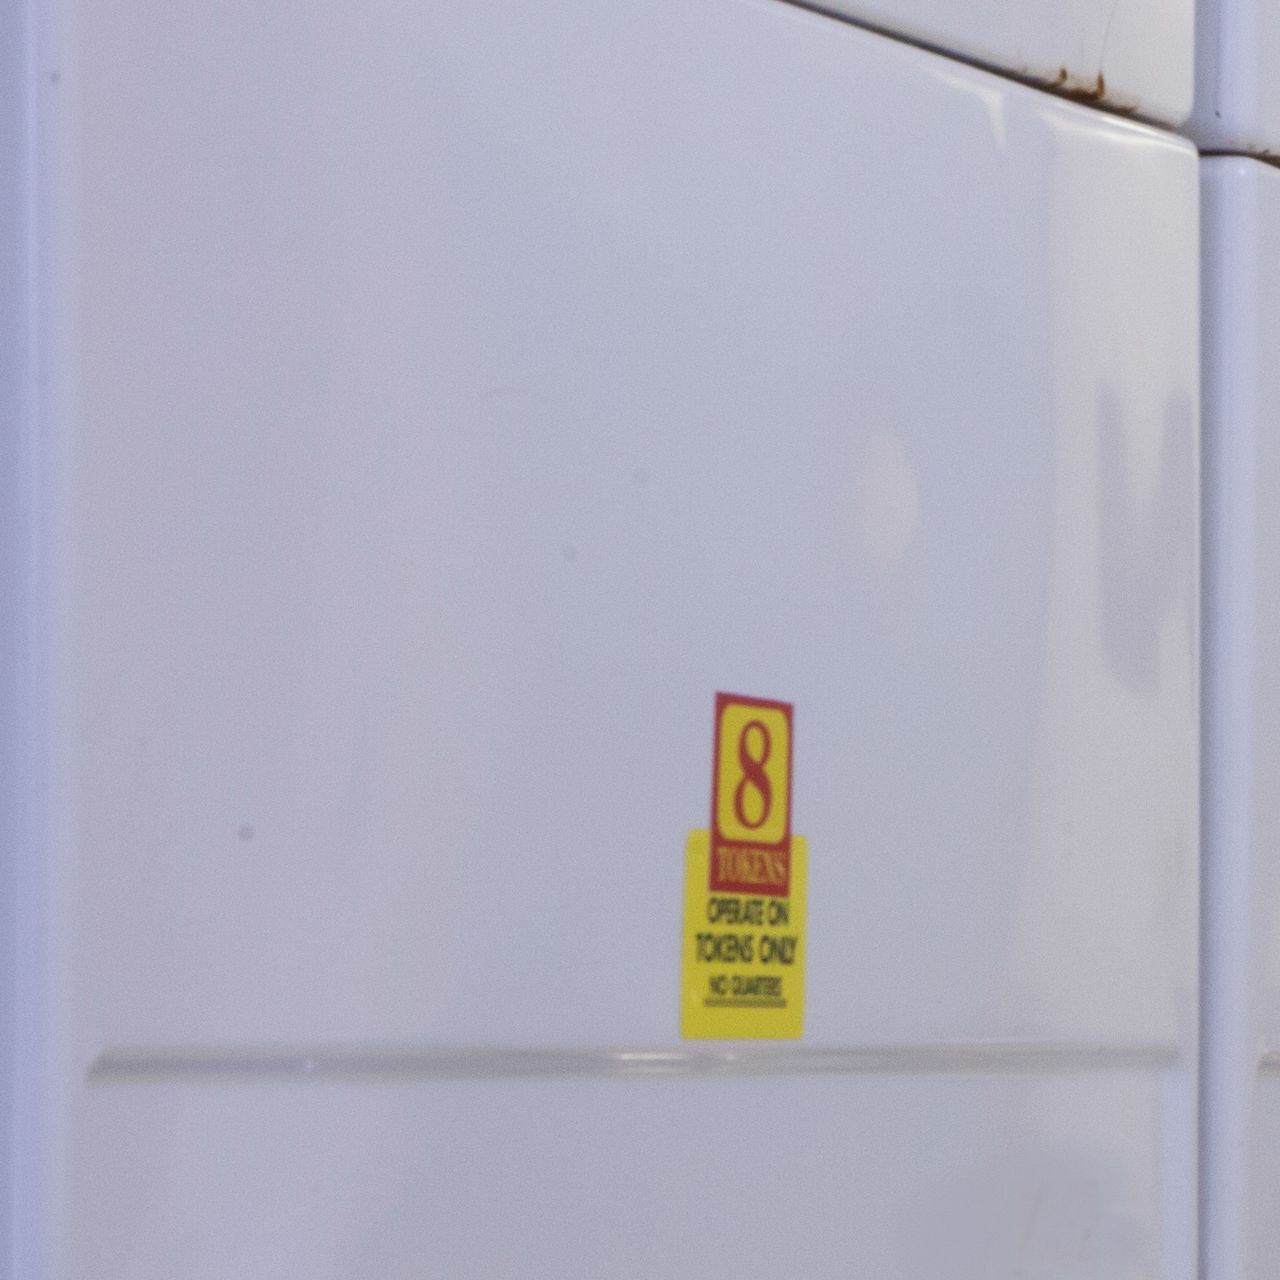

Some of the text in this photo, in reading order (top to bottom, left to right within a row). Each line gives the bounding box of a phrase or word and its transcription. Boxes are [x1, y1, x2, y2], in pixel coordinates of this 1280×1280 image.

[734, 720, 772, 830] 8
[719, 846, 786, 886] TOKENS
[708, 898, 789, 926] OPERATE ON
[696, 933, 797, 965] TOKENS ONLY
